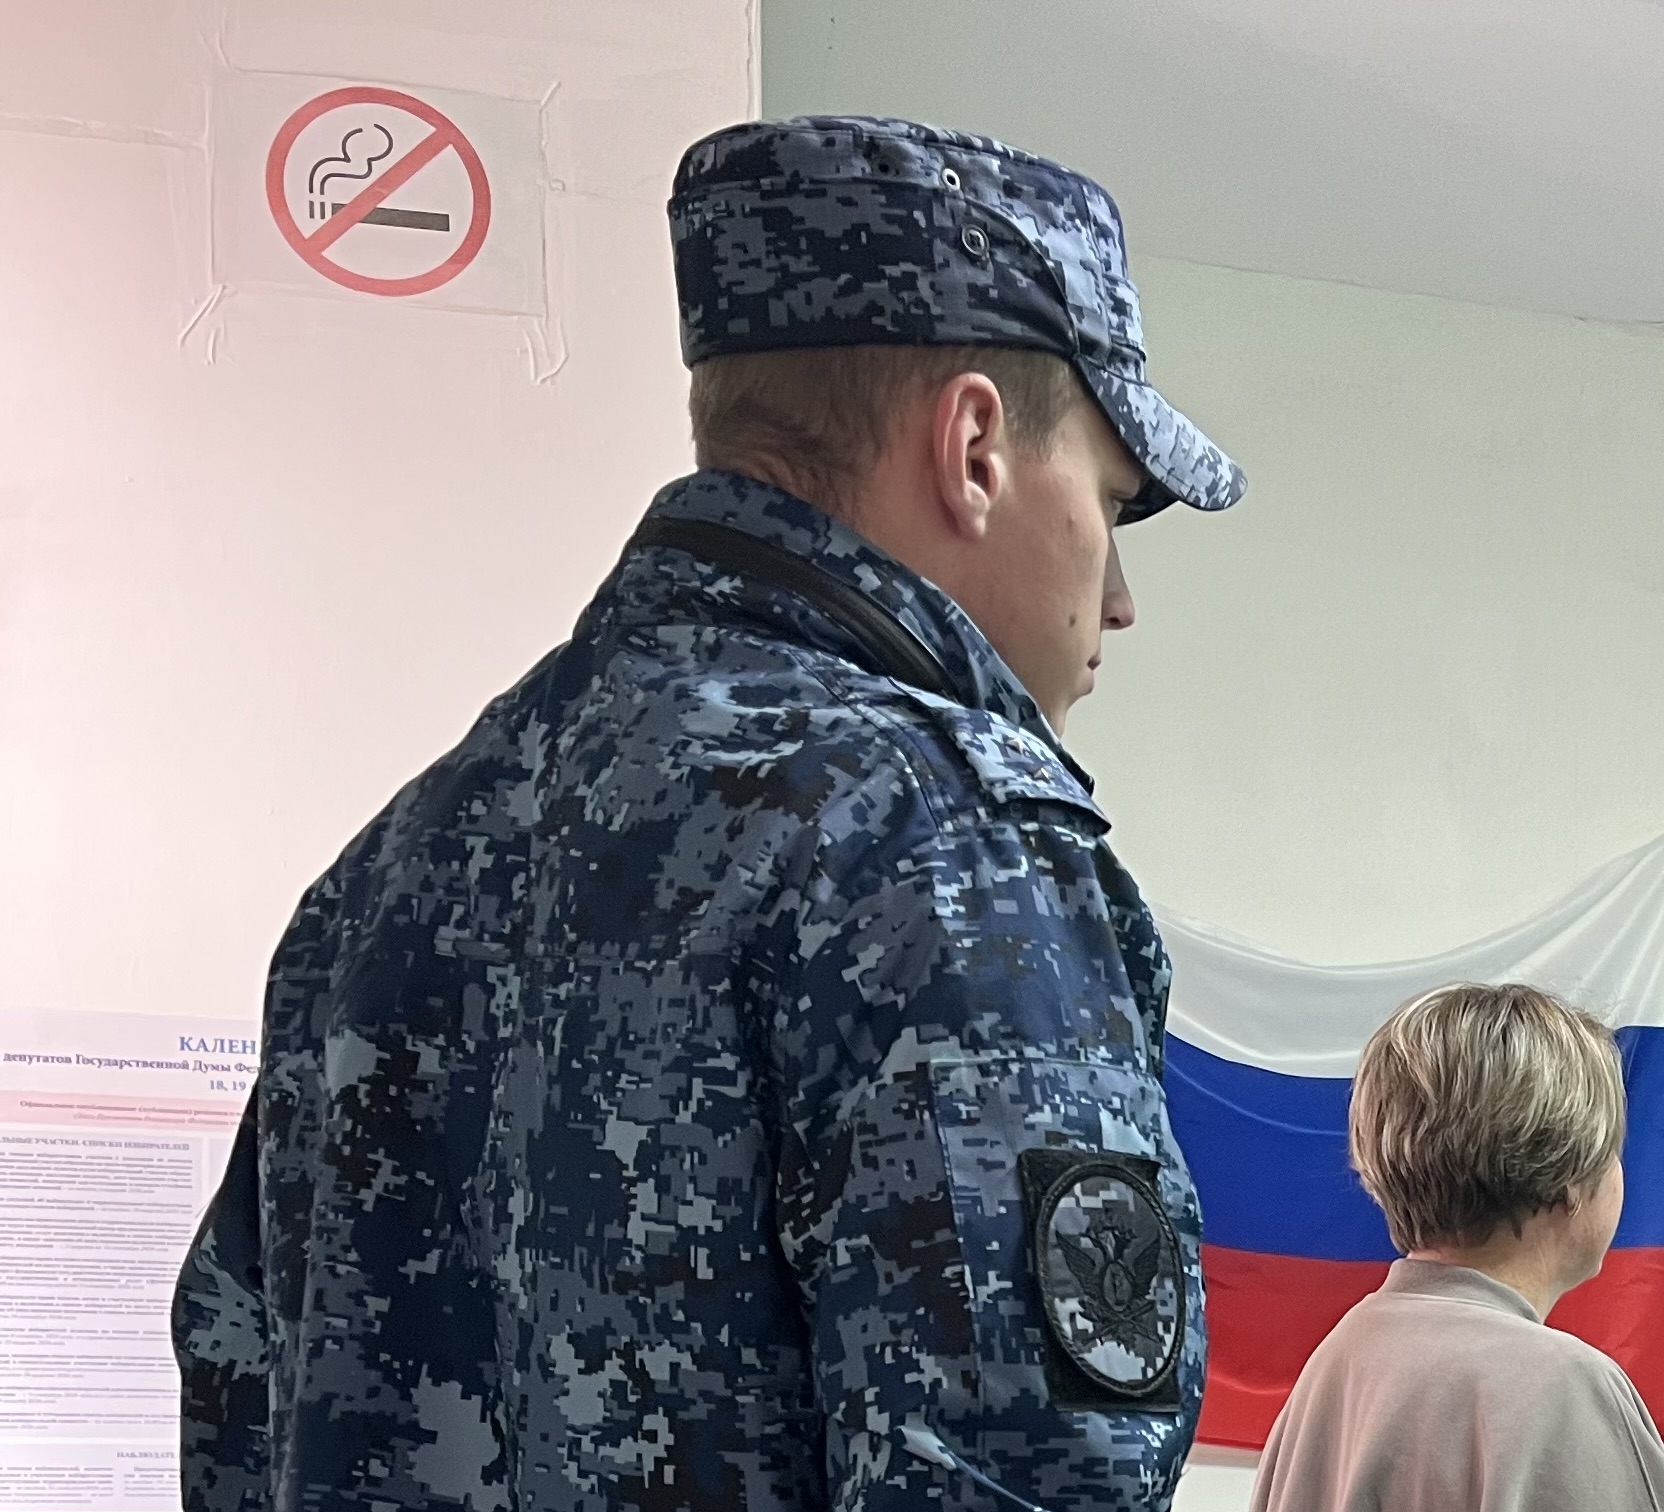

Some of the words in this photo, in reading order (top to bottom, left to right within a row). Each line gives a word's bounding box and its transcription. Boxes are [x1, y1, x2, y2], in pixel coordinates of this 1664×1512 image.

[179, 1036, 257, 1055] КАЛЕН
[4, 1053, 72, 1065] депутатов
[75, 1054, 190, 1070] Государственной
[192, 1060, 231, 1074] Думы
[232, 1081, 246, 1091] 19
